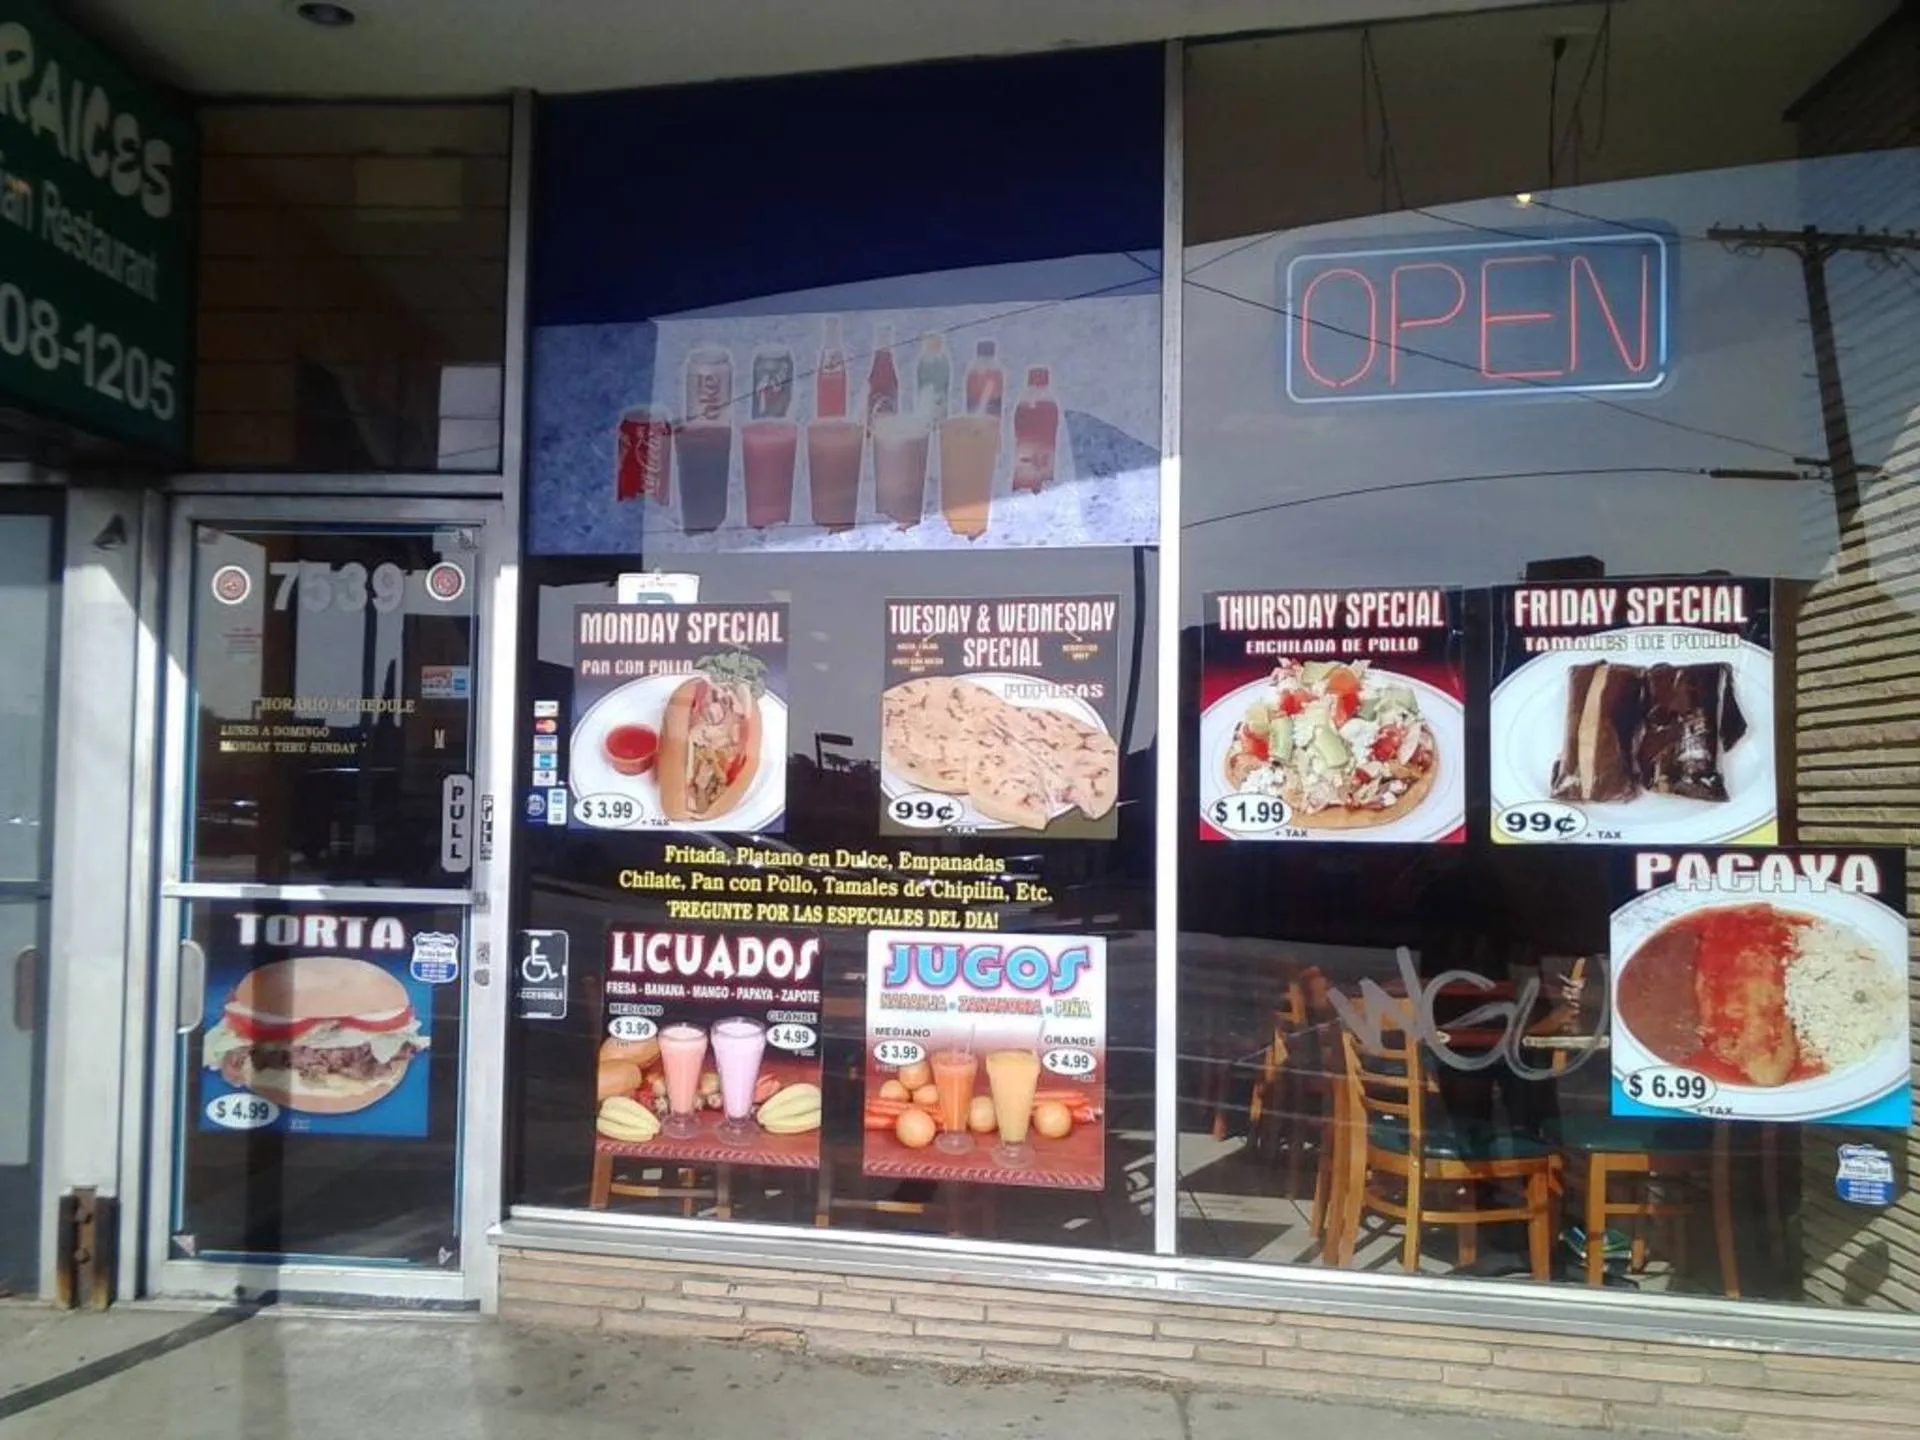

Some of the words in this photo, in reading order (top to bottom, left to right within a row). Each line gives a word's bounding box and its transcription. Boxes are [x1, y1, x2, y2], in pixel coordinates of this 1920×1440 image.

[0, 20, 174, 218] RAICES
[43, 181, 158, 301] Restaurant
[1301, 254, 1649, 387] OPEN
[0, 283, 175, 421] 08-1205
[269, 560, 405, 613] 7539
[889, 603, 972, 635] TUESDAY
[976, 605, 991, 633] &
[997, 601, 1116, 633] WEDNESDAY
[1217, 593, 1338, 631] THURSDAY
[1345, 590, 1445, 629] SPECIAL
[1514, 588, 1617, 627] FRIDAY
[1626, 586, 1749, 625] SPECIAL
[580, 612, 680, 644] MONDAY
[687, 611, 784, 644] SPECIAL
[963, 637, 1043, 667] SPECIAL
[1245, 639, 1337, 655] ENCHILADA
[1342, 638, 1363, 653] DE
[1367, 636, 1420, 652] POLLO
[1524, 634, 1628, 652] TAMALES
[1637, 633, 1666, 650] DE
[1671, 632, 1742, 650] POLLO
[581, 659, 611, 676] PAN
[615, 659, 645, 675] CON
[1004, 683, 1105, 698] PUPUSAS
[220, 724, 261, 737] LUNES
[262, 725, 271, 737] A
[273, 725, 330, 739] DOMINGO
[219, 740, 271, 753] MONDAY
[310, 742, 358, 754] SUNDAY
[582, 800, 593, 819] $
[597, 801, 633, 819] 3.99
[895, 801, 955, 822] 99¢
[1214, 802, 1228, 824] $
[1237, 801, 1285, 823] 1.99
[450, 785, 465, 860] PULL
[1286, 829, 1308, 838] TAX
[1505, 811, 1577, 838] 99¢
[1597, 830, 1622, 839] TAX
[664, 844, 731, 866] Fritada,
[736, 846, 804, 867] Platano
[808, 852, 830, 867] en
[835, 848, 893, 871] Dulce,
[899, 850, 1006, 876] Empanadas
[619, 868, 686, 891] Chilate,
[690, 871, 725, 891] Pan
[729, 877, 762, 892] con
[766, 874, 819, 895] Pollo,
[822, 875, 899, 897] Tamales
[903, 879, 926, 898] de
[1015, 882, 1054, 902] Etc.
[1635, 851, 1881, 895] PACAYA
[756, 902, 789, 922] POR
[793, 904, 823, 924] LAS
[827, 904, 924, 928] ESPECIALES
[927, 908, 962, 929] DEL
[965, 909, 1000, 930] DIA!
[235, 912, 406, 950] TORTA
[610, 931, 820, 982] LICUADOS
[883, 940, 1093, 996] JUGOS
[606, 980, 637, 995] FRESA
[644, 983, 685, 997] BANANA
[692, 985, 730, 1000] MANGO
[736, 987, 774, 1001] PAPAYA
[781, 988, 820, 1004] ZAPOTE
[614, 1020, 621, 1034] $
[625, 1021, 650, 1036] 3.99
[773, 1028, 780, 1042] $
[783, 1030, 809, 1044] 4.99
[874, 1027, 931, 1038] MEDIANO
[1044, 1034, 1097, 1047] GRANDE
[880, 1044, 888, 1059] $
[891, 1045, 918, 1060] 3.99
[1049, 1053, 1057, 1069] $
[1062, 1055, 1089, 1070] 4.99
[1628, 1073, 1643, 1098] $
[1652, 1075, 1707, 1099] 6.99
[215, 1100, 227, 1119] $
[232, 1100, 270, 1120] 4.99
[1707, 1106, 1734, 1115] TAX
